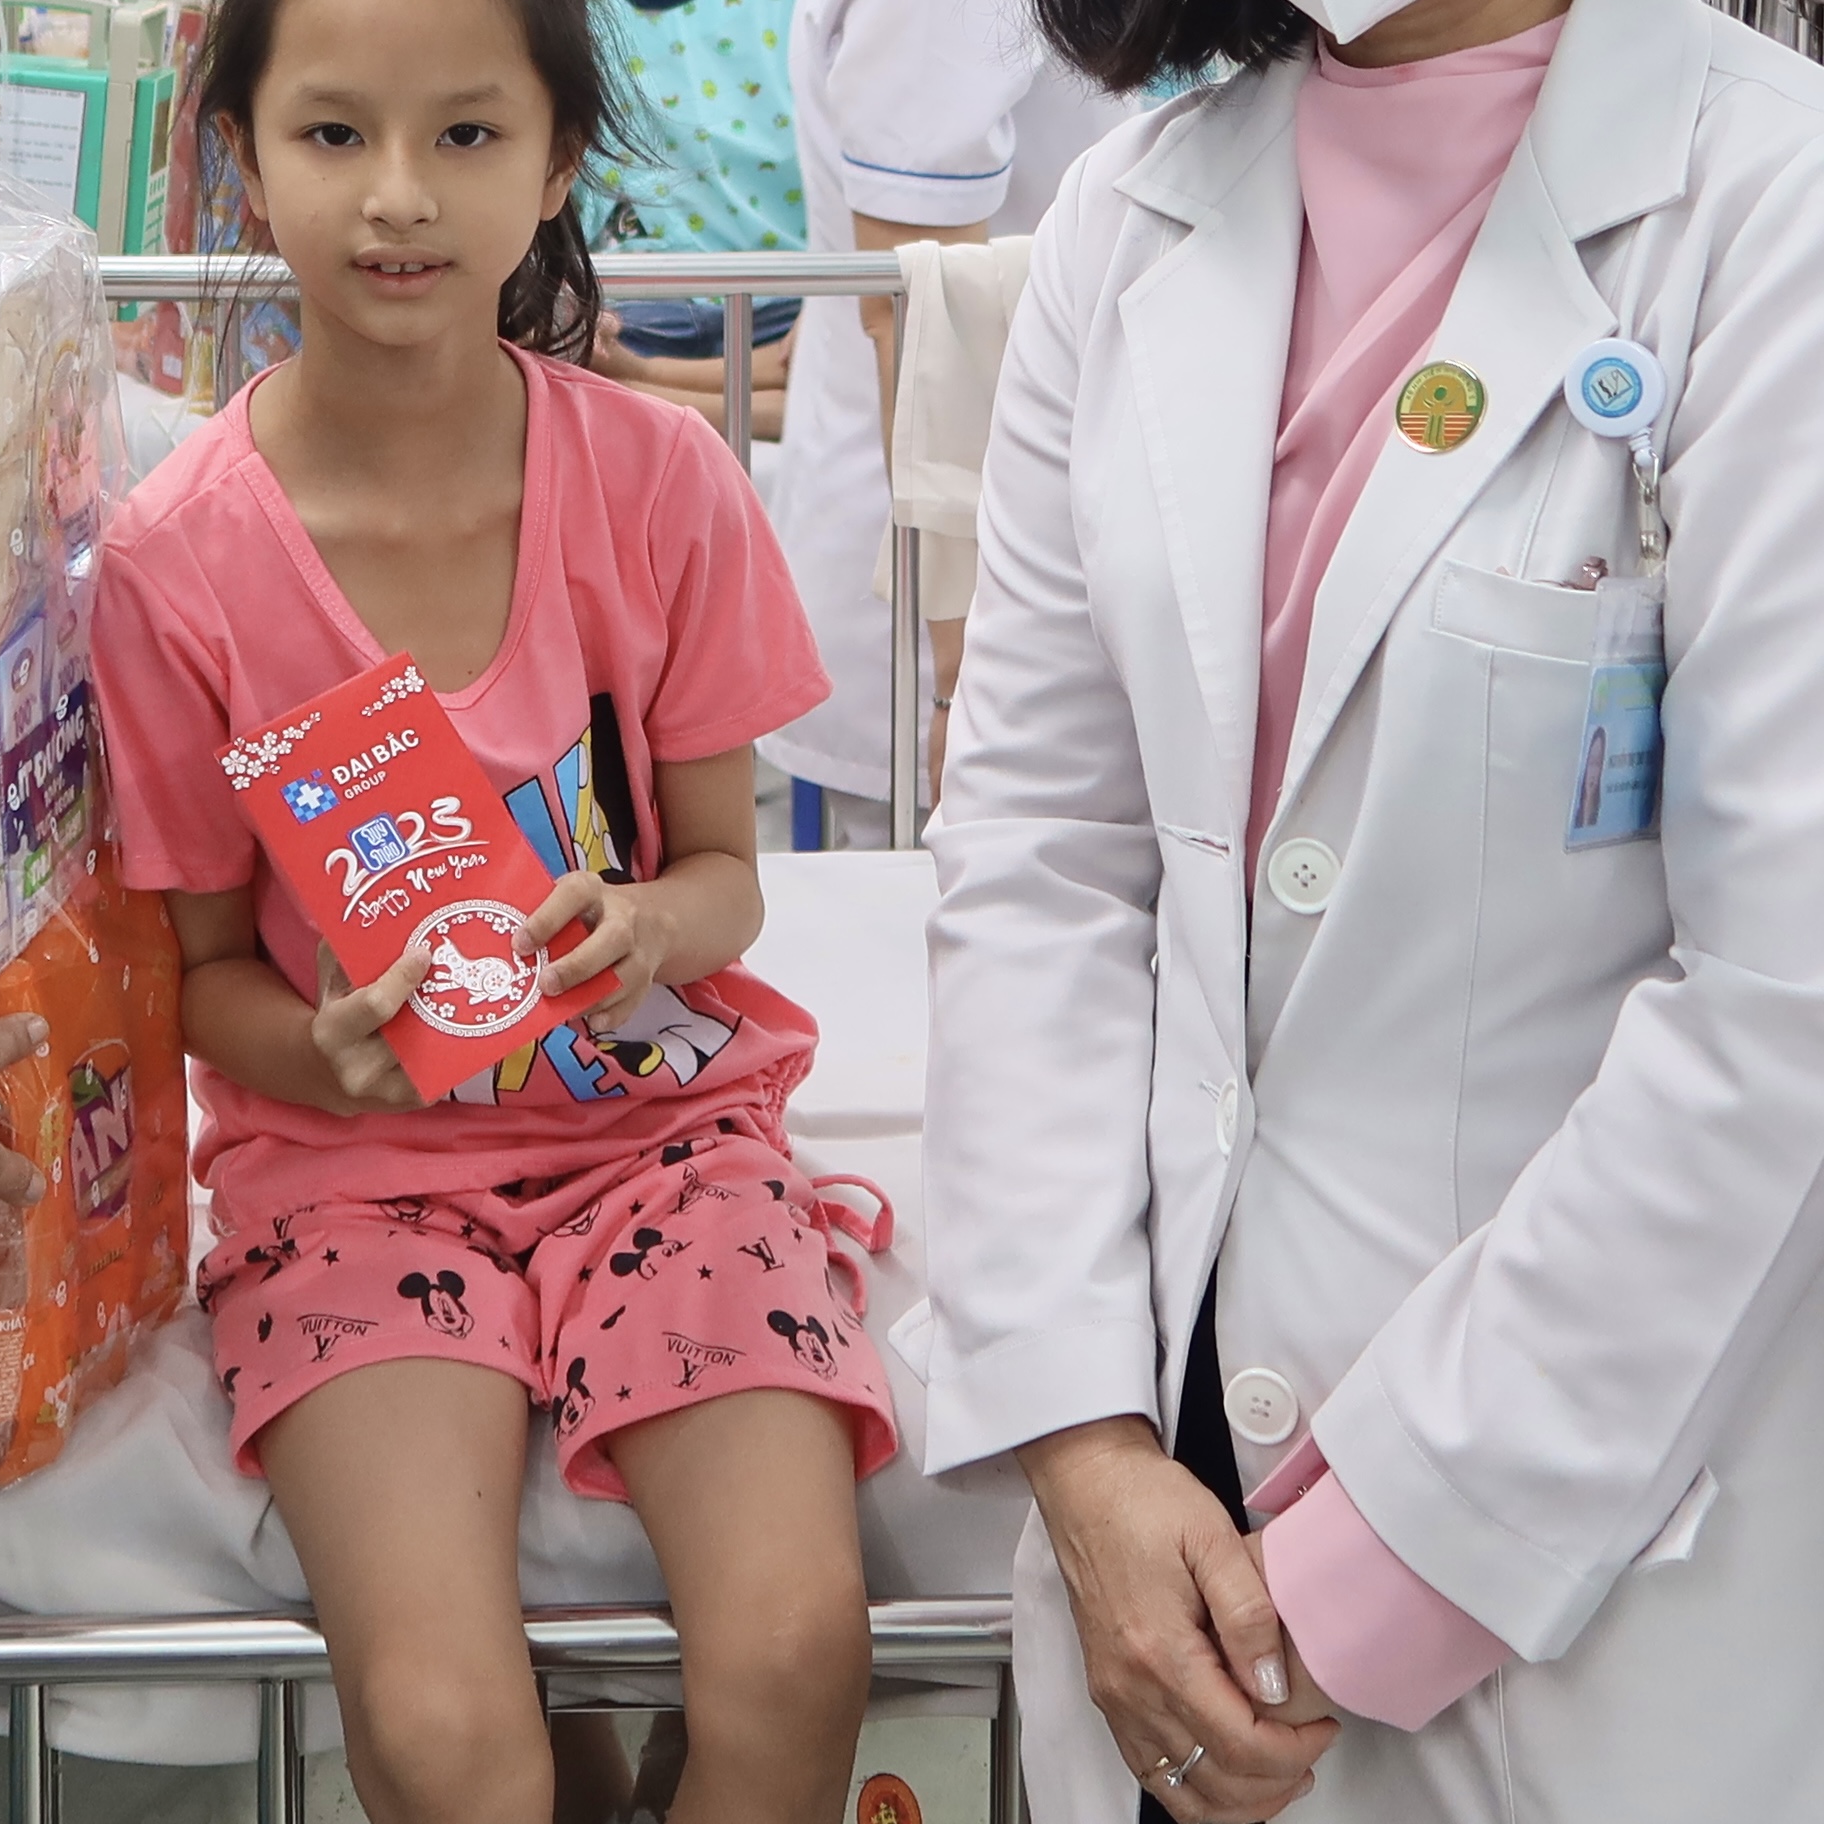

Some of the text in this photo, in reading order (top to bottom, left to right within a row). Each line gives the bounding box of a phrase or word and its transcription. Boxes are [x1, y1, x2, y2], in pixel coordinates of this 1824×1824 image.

[331, 729, 421, 787] ĐẠI BẮC
[344, 769, 387, 800] GROUP
